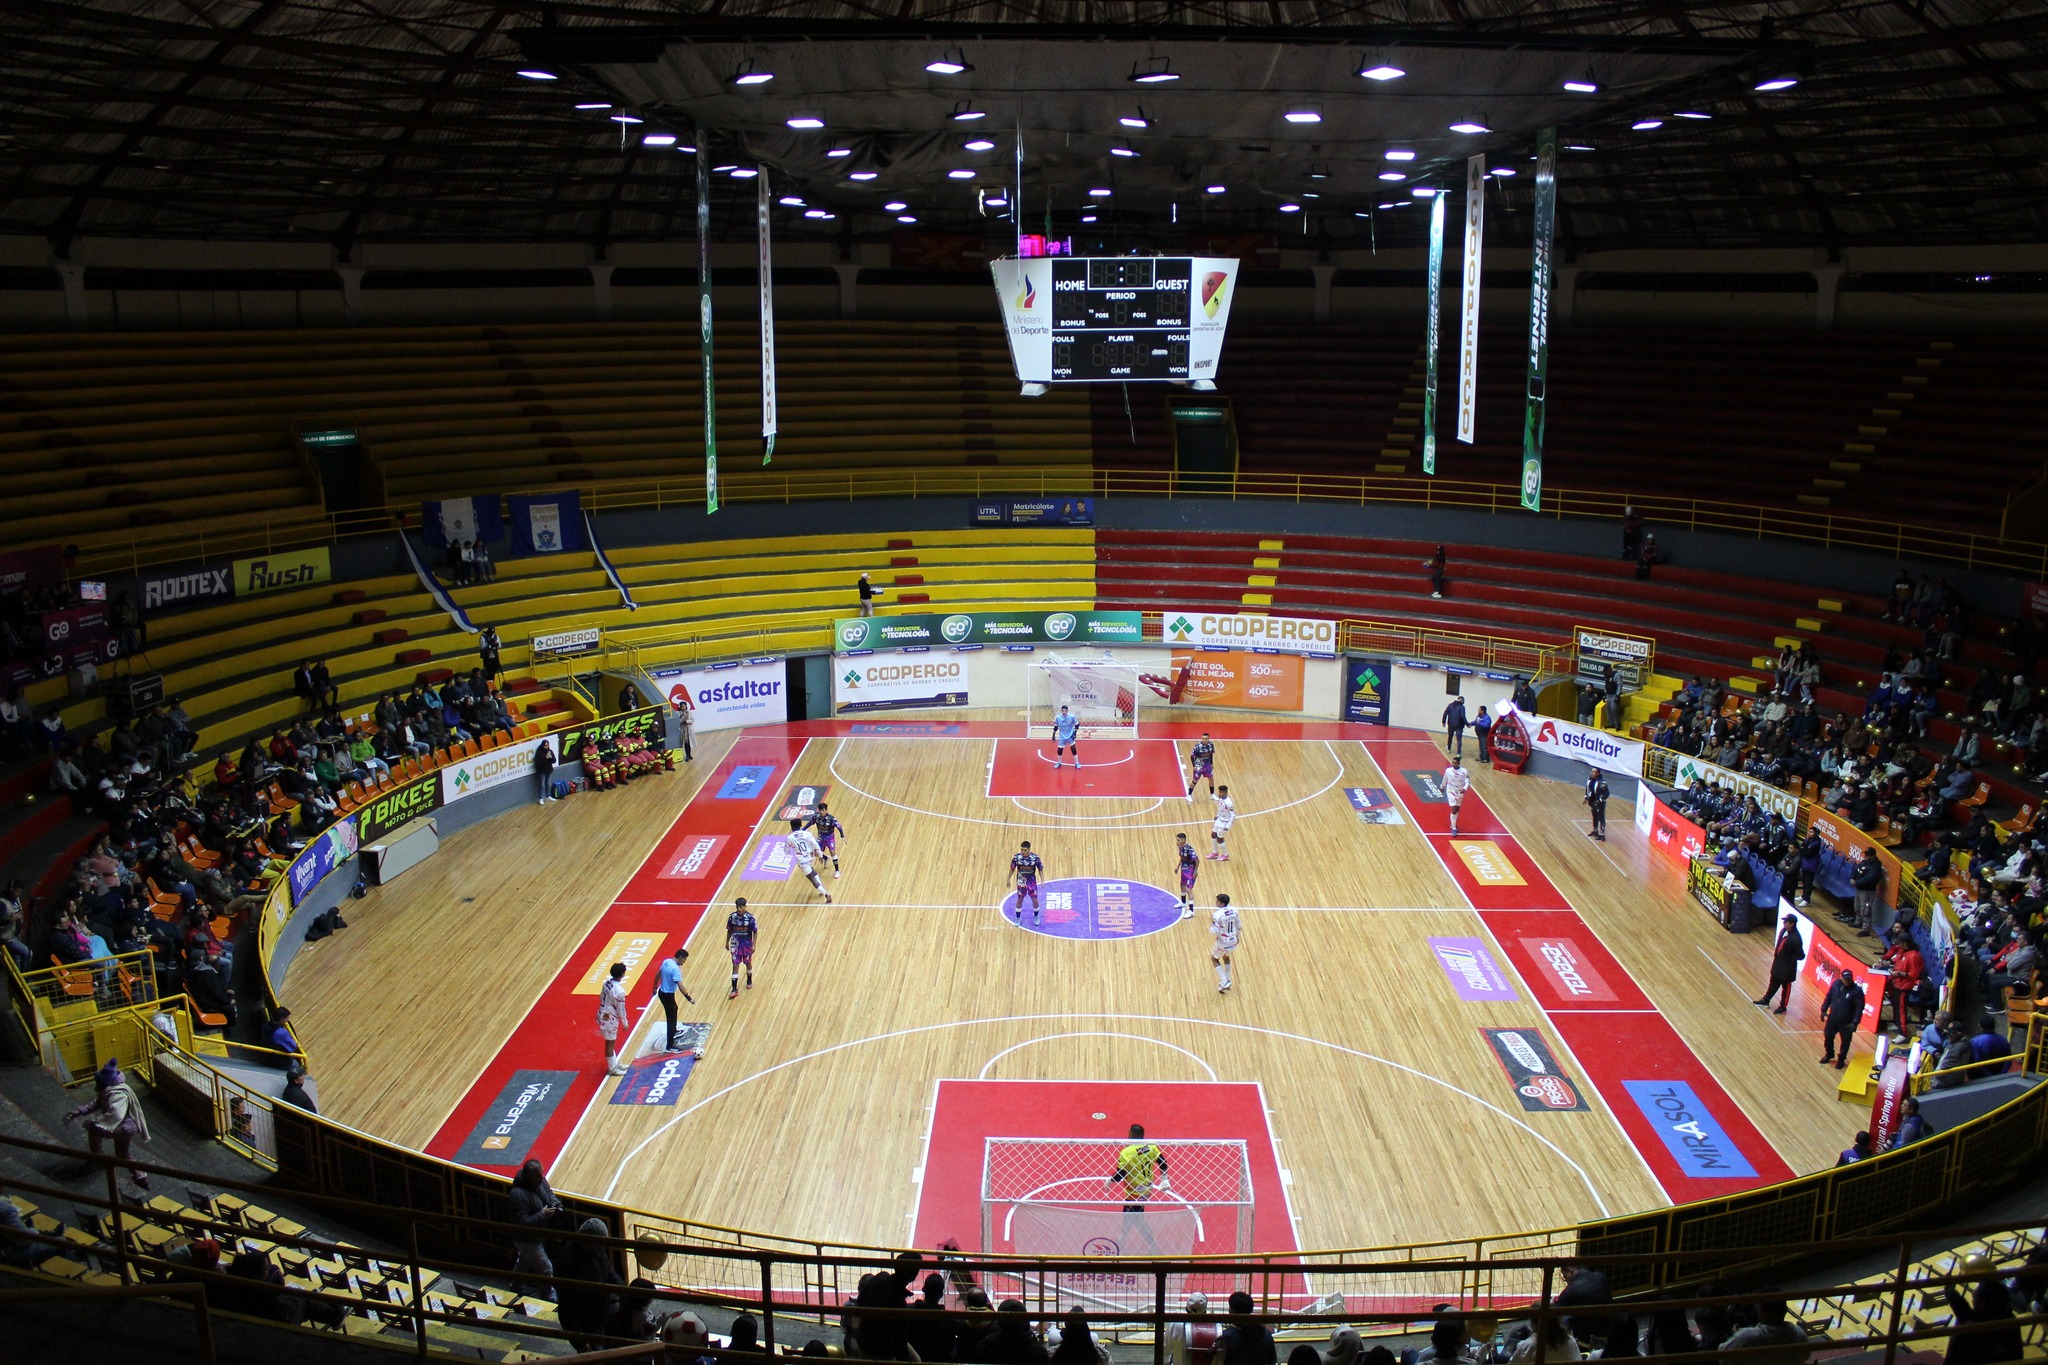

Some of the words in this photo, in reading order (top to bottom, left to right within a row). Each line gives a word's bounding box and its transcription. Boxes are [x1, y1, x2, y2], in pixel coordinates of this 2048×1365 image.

[1055, 280, 1085, 291] HOME
[1156, 279, 1189, 290] GUEST
[1106, 292, 1136, 300] PERIOD
[1530, 238, 1544, 371] INTERNET
[1462, 199, 1478, 435] COOPERCO
[1020, 326, 1049, 336] Deporte
[248, 560, 315, 592] Rush
[49, 621, 70, 641] GO
[880, 627, 930, 639] +TECNOLOGÍA
[881, 625, 894, 633] MÁS
[945, 621, 966, 637] GO
[984, 625, 1033, 635] +TECNOLOGÍA
[1049, 619, 1069, 634] GO
[1087, 626, 1137, 634] +TECNOLOGÍA
[1200, 616, 1332, 642] COOPERCO
[545, 631, 597, 647] COOPERCO
[843, 627, 863, 642] GO
[562, 644, 587, 653] solvencia
[1201, 637, 1249, 648] COOPERATIVA
[1300, 642, 1331, 651] CRÉDITO
[1590, 637, 1647, 655] COOPERCO
[1607, 652, 1634, 661] solvencia
[866, 663, 960, 682] COOPERCO
[1208, 670, 1235, 678] MEJOR
[1209, 663, 1226, 671] GOL
[1250, 666, 1270, 675] 300
[1580, 662, 1598, 672] SALIDA
[1187, 680, 1215, 688] ETAPA
[1248, 687, 1268, 696] 400
[698, 680, 781, 704] asfaltar
[1353, 693, 1381, 701] COOPERCO
[717, 704, 749, 713] conectando
[750, 701, 766, 709] vidas
[1562, 732, 1622, 758] asfaltar
[473, 748, 536, 782] COOPERC
[474, 776, 499, 789] COOPERATIVA
[729, 767, 763, 796] MIRASOL
[1703, 767, 1796, 820] COOPERCO
[384, 812, 406, 830] MOTO
[415, 799, 434, 815] BIKE
[1826, 829, 1840, 842] MEJOR
[1828, 823, 1837, 833] GOL
[1849, 845, 1861, 860] 300
[1469, 854, 1503, 880] ETAPA
[1060, 892, 1073, 910] RADIO
[1227, 921, 1233, 933] 11
[605, 945, 621, 961] NUEVO
[645, 1059, 681, 1104] ochoa's
[1883, 1075, 1898, 1100] Water
[535, 1083, 553, 1102] HOME
[1538, 1077, 1567, 1105] PIGGIS
[1878, 1098, 1894, 1127] Spring
[1649, 1087, 1731, 1169] MIRASOL
